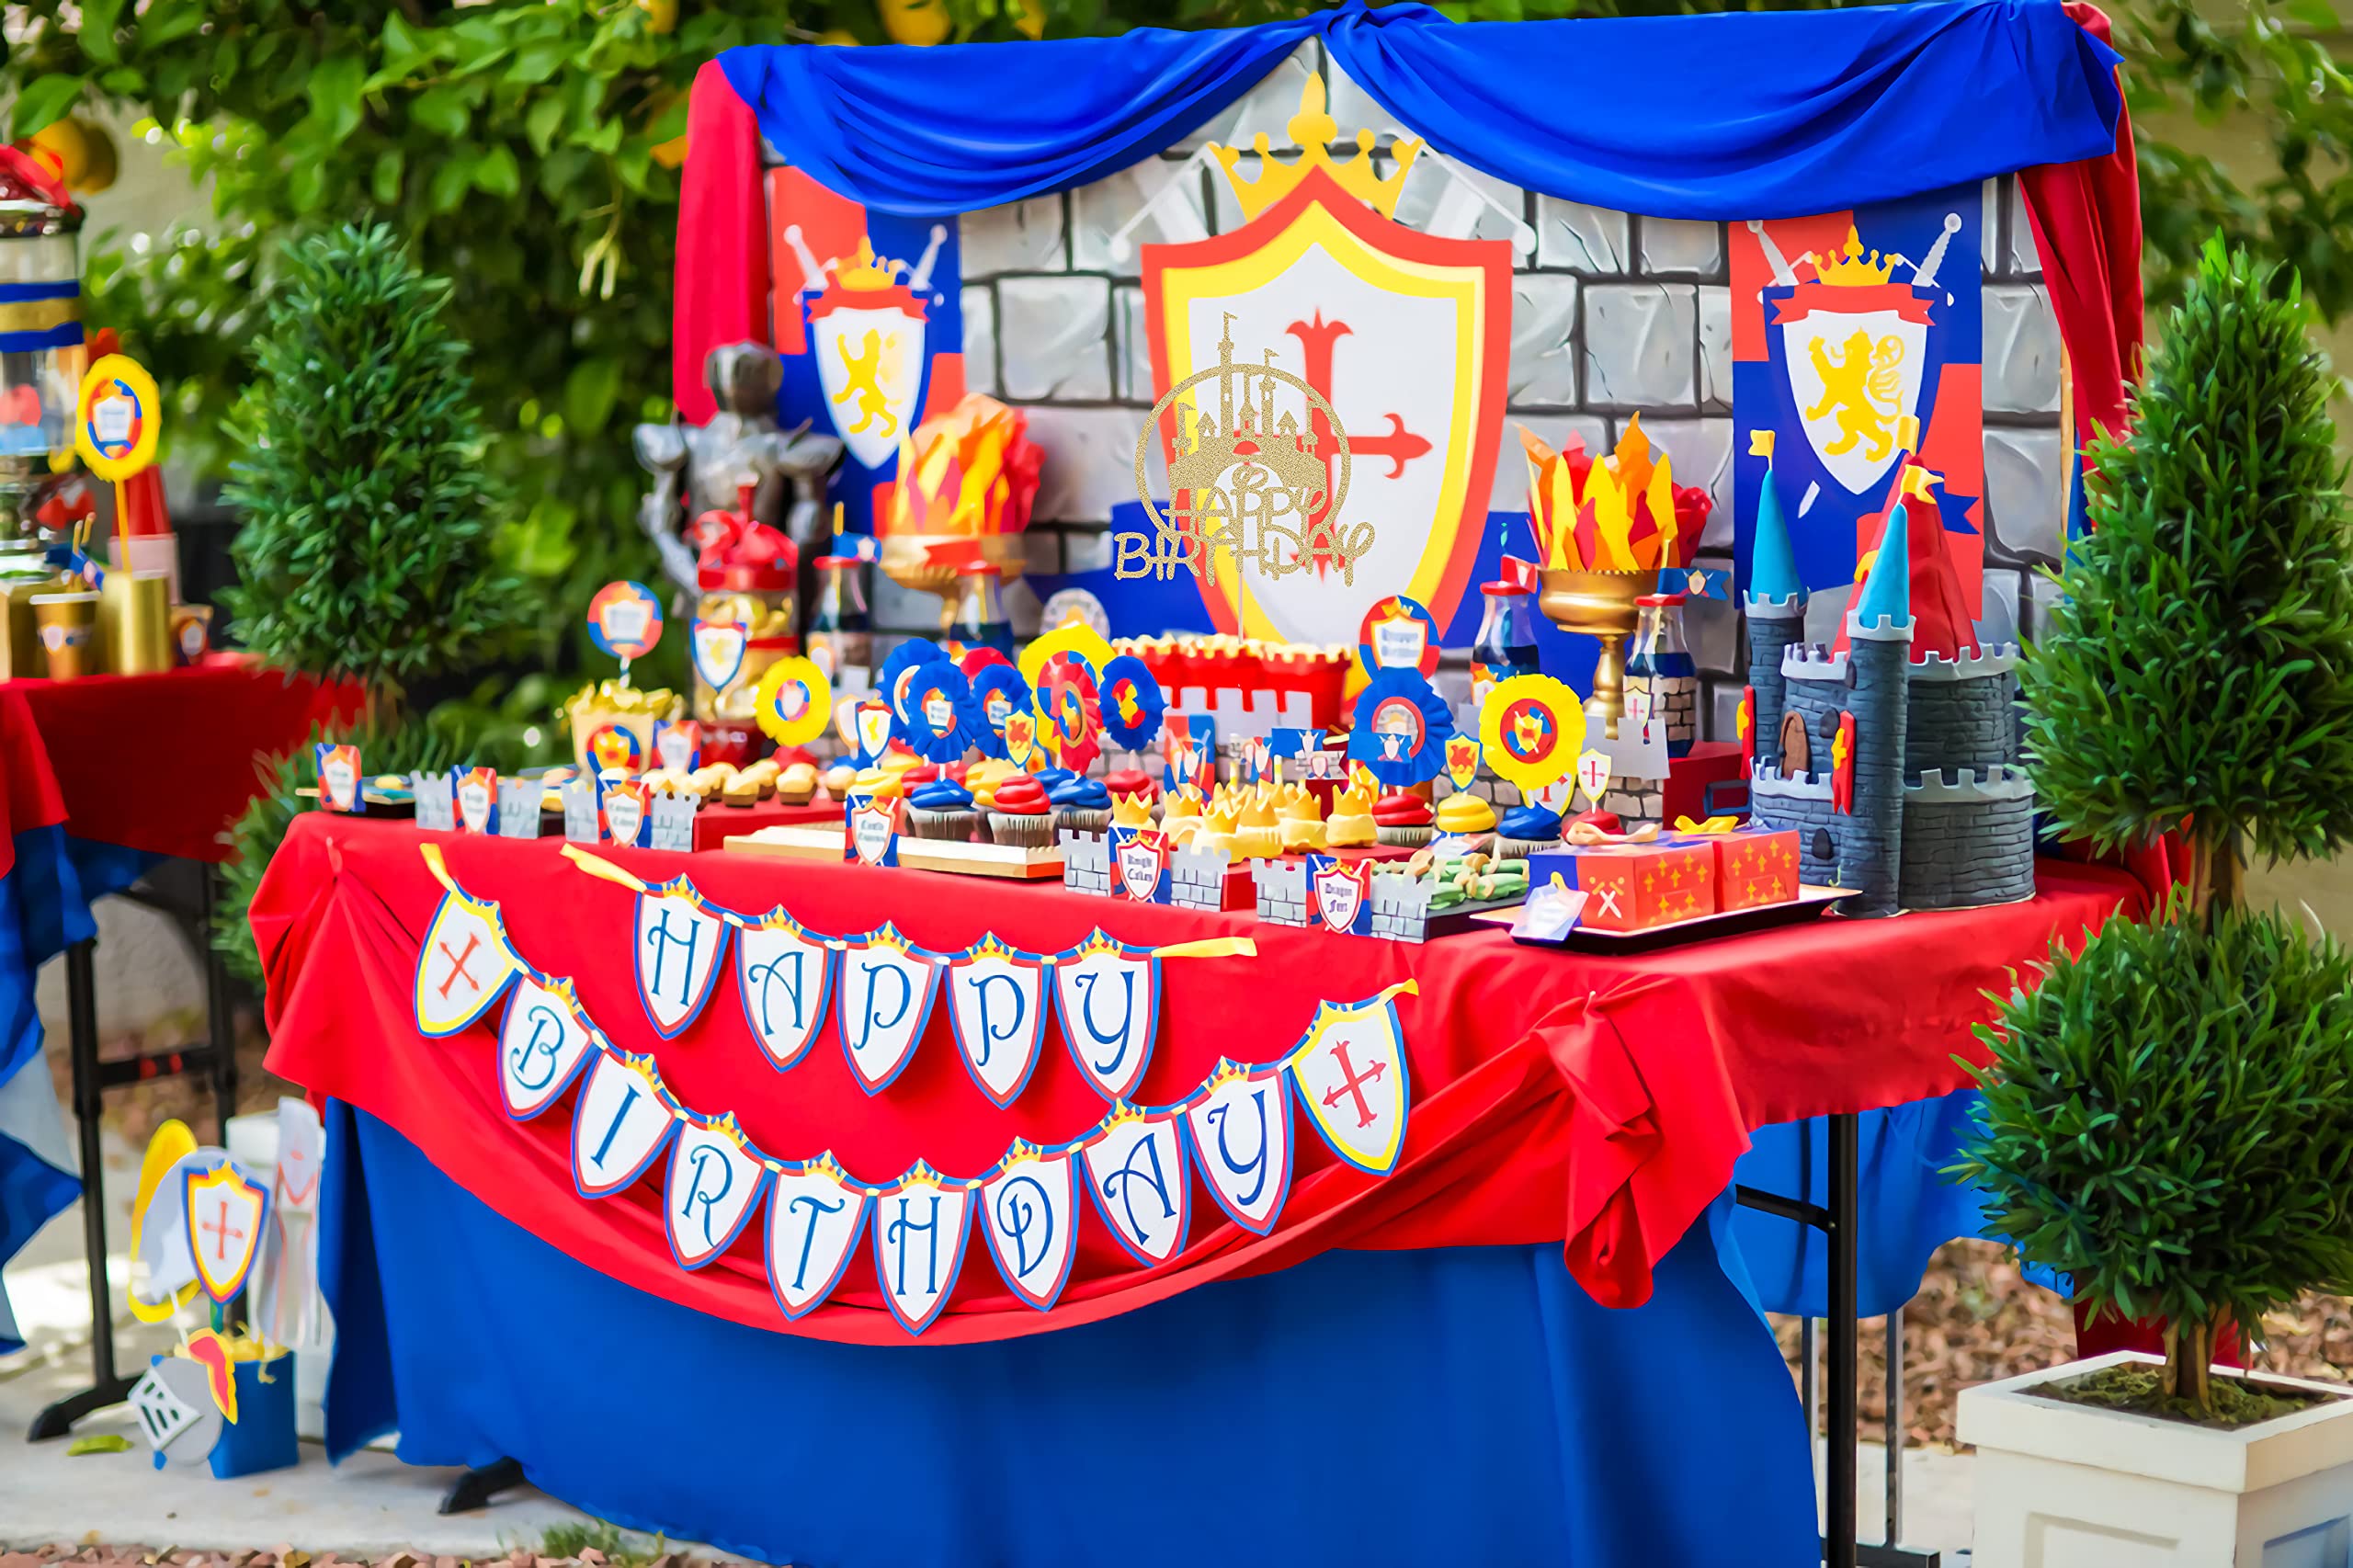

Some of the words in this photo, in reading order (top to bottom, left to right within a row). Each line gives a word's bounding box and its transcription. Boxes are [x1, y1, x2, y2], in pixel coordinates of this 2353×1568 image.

[1113, 520, 1376, 588] BIRTHDAY
[647, 907, 1135, 1075] HAPPY
[509, 1006, 1268, 1296] BIRTHDAY
